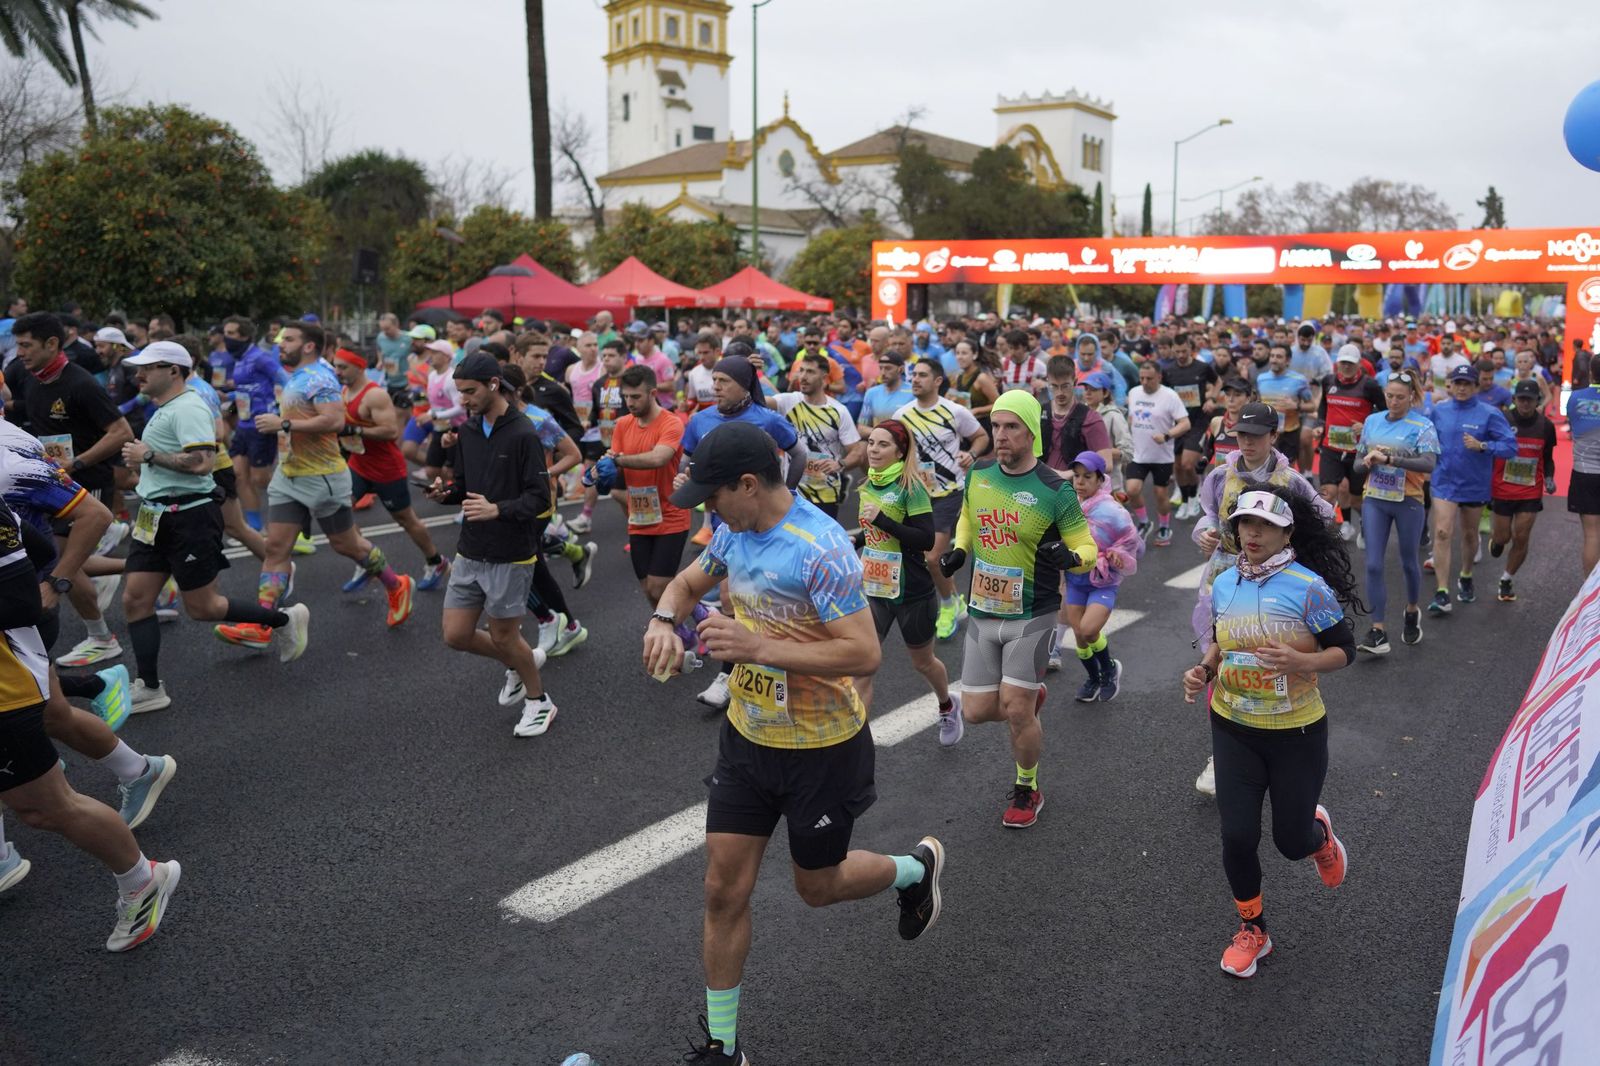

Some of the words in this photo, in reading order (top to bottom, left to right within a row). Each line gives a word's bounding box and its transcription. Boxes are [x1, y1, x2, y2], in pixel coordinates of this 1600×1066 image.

[976, 508, 1020, 530] RUN
[978, 528, 1019, 550] RUN
[863, 561, 889, 578] 7388
[979, 574, 1009, 594] 7387
[734, 664, 774, 697] 18267
[1223, 667, 1275, 690] 11532
